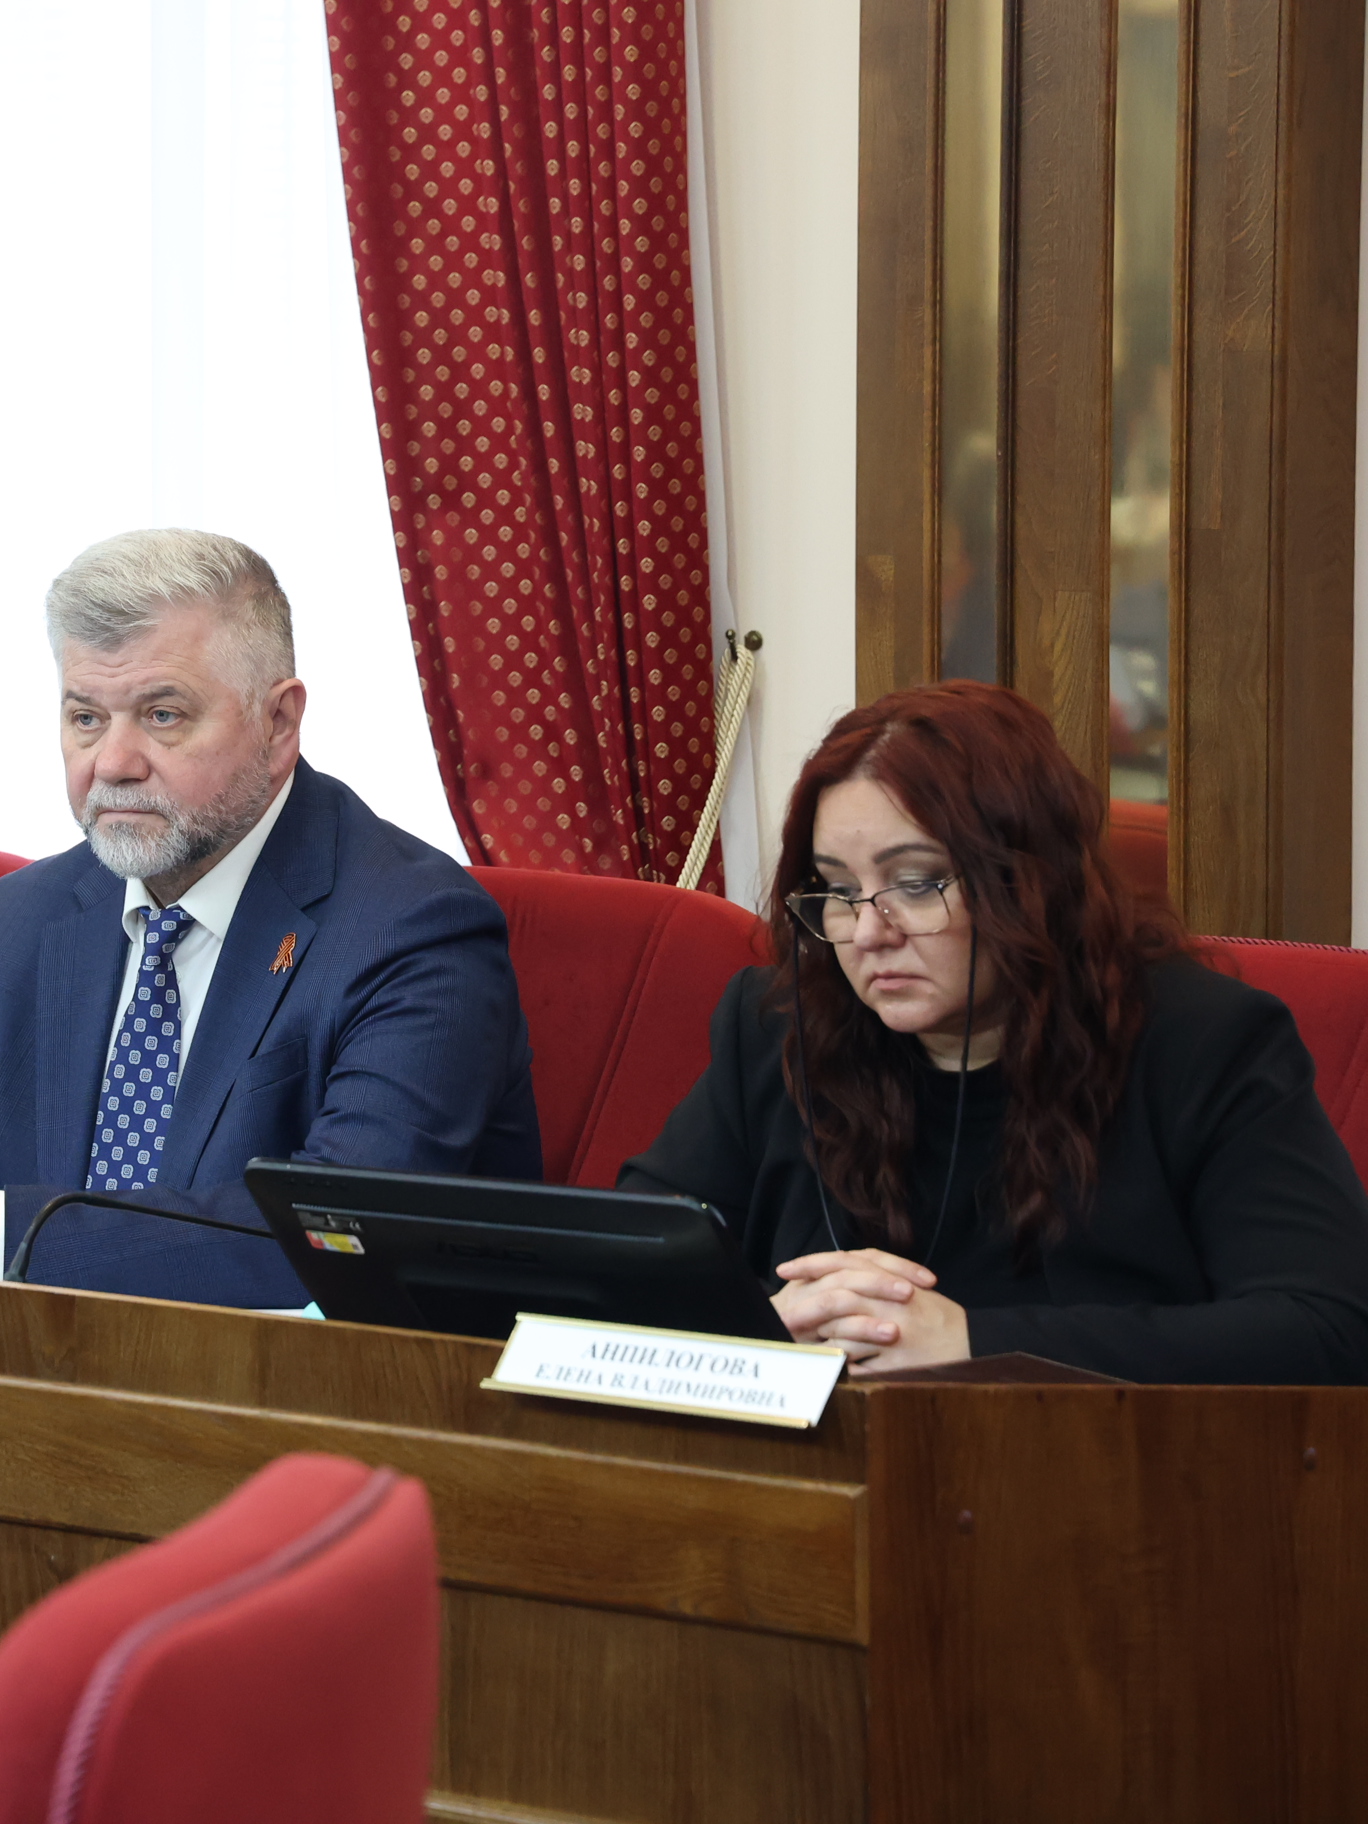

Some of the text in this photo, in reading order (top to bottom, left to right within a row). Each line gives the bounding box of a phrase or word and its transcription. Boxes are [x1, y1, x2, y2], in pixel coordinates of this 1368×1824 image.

[583, 1341, 761, 1379] АНПИЛОГОВА
[534, 1363, 787, 1408] ЕЛЕНА ВЛАДИМИРОВНА
